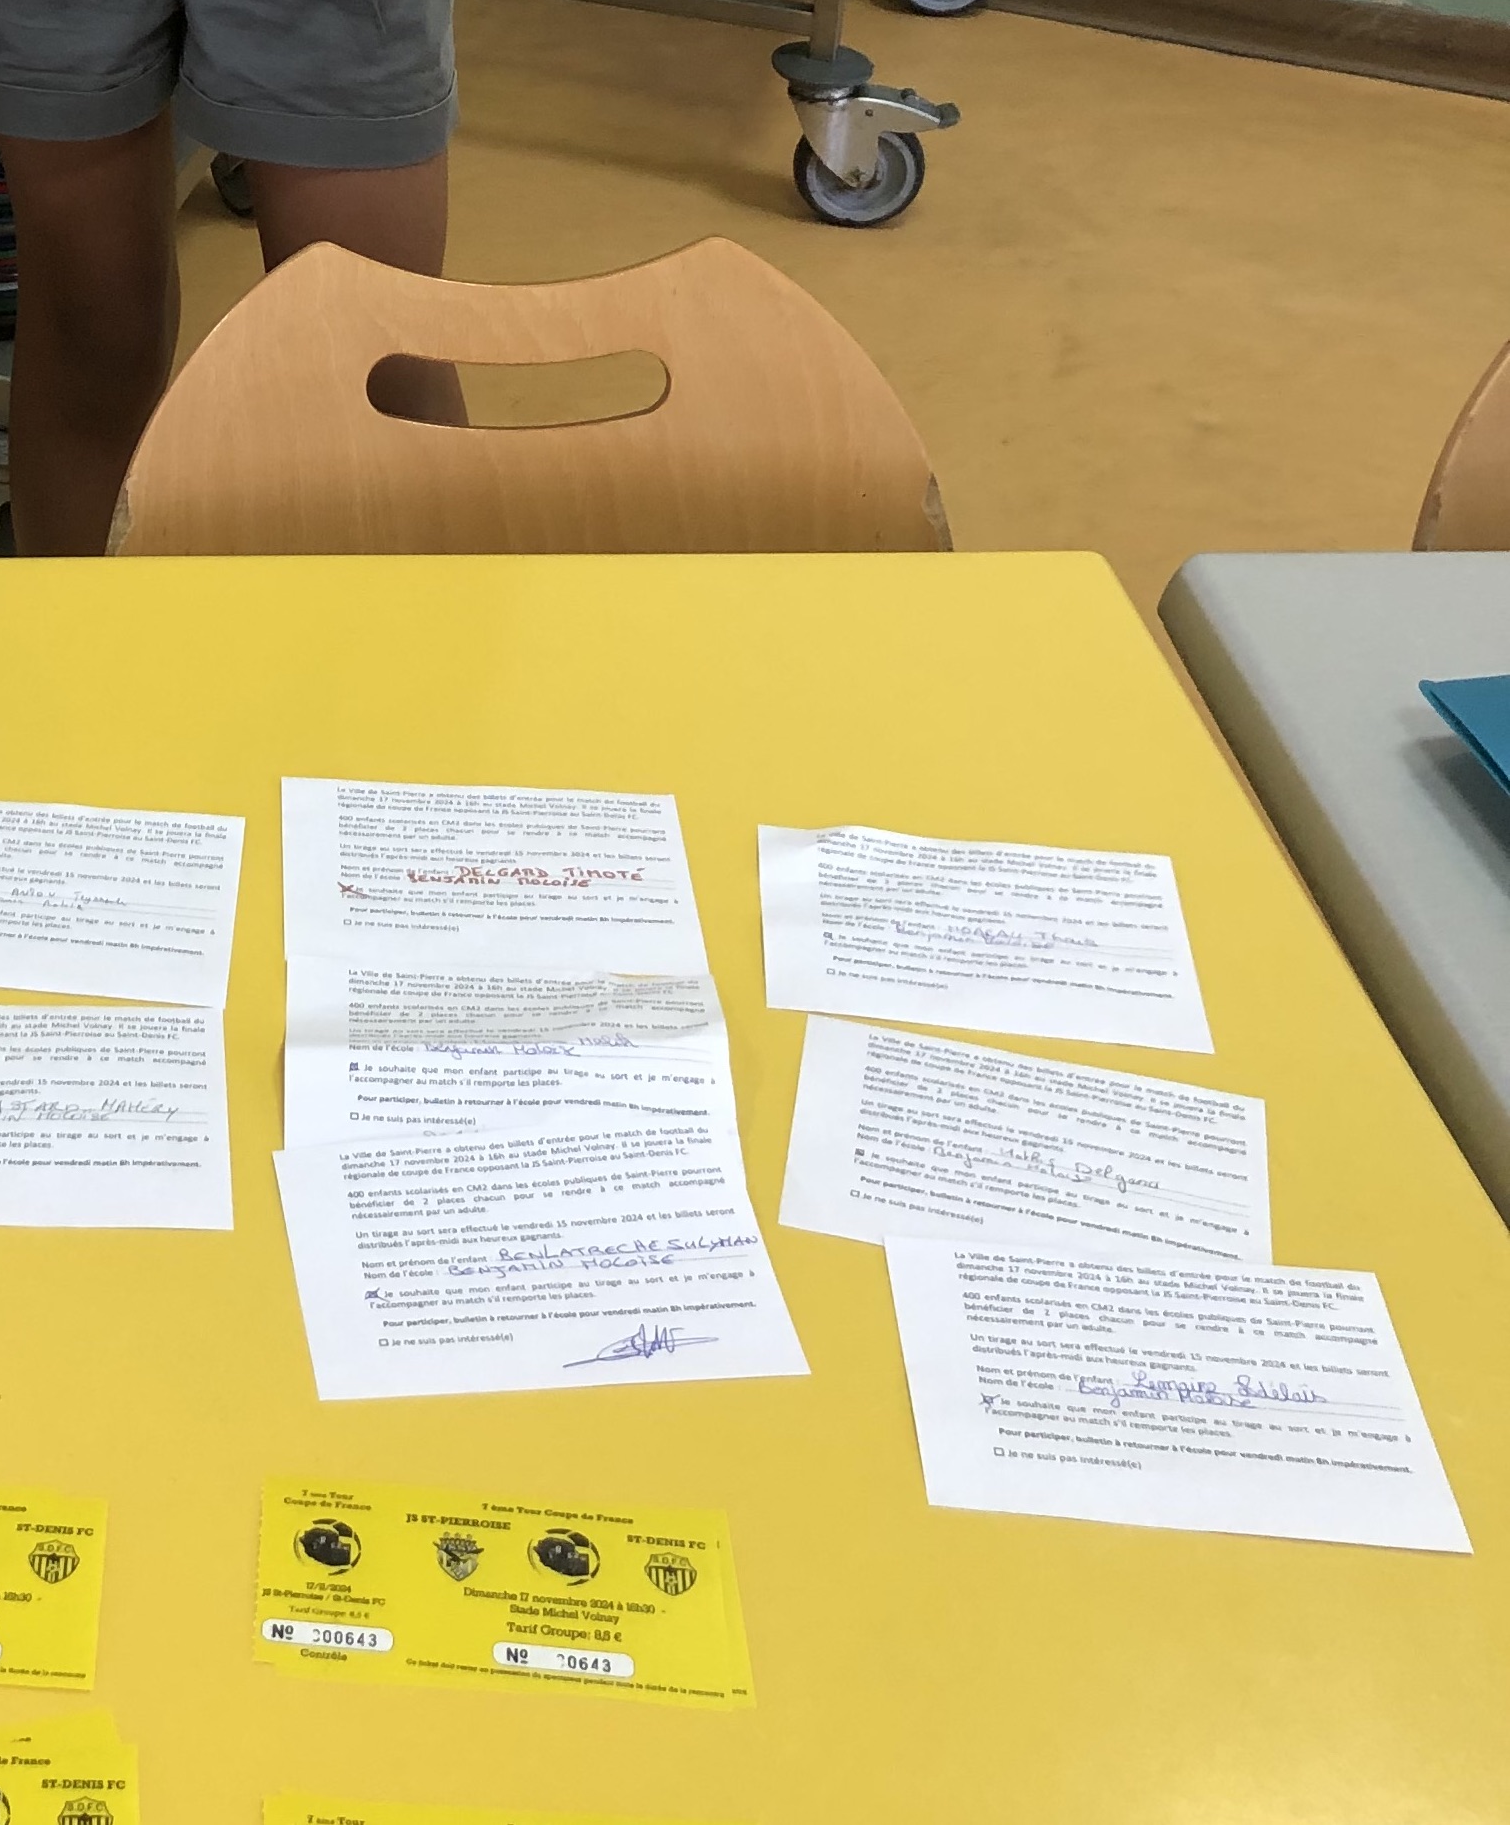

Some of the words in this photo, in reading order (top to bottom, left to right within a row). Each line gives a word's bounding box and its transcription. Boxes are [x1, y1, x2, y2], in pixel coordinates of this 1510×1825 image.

[406, 1513, 419, 1523] JS
[421, 1514, 511, 1530] ST-PIERROISE
[16, 1523, 74, 1535] ST-DENIS
[77, 1527, 94, 1536] FC
[626, 1534, 686, 1548] ST-DENIS
[689, 1540, 706, 1549] FC
[300, 1649, 348, 1661] Contrôle
[41, 1779, 104, 1790] ST-DENIS
[107, 1780, 126, 1790] FC
